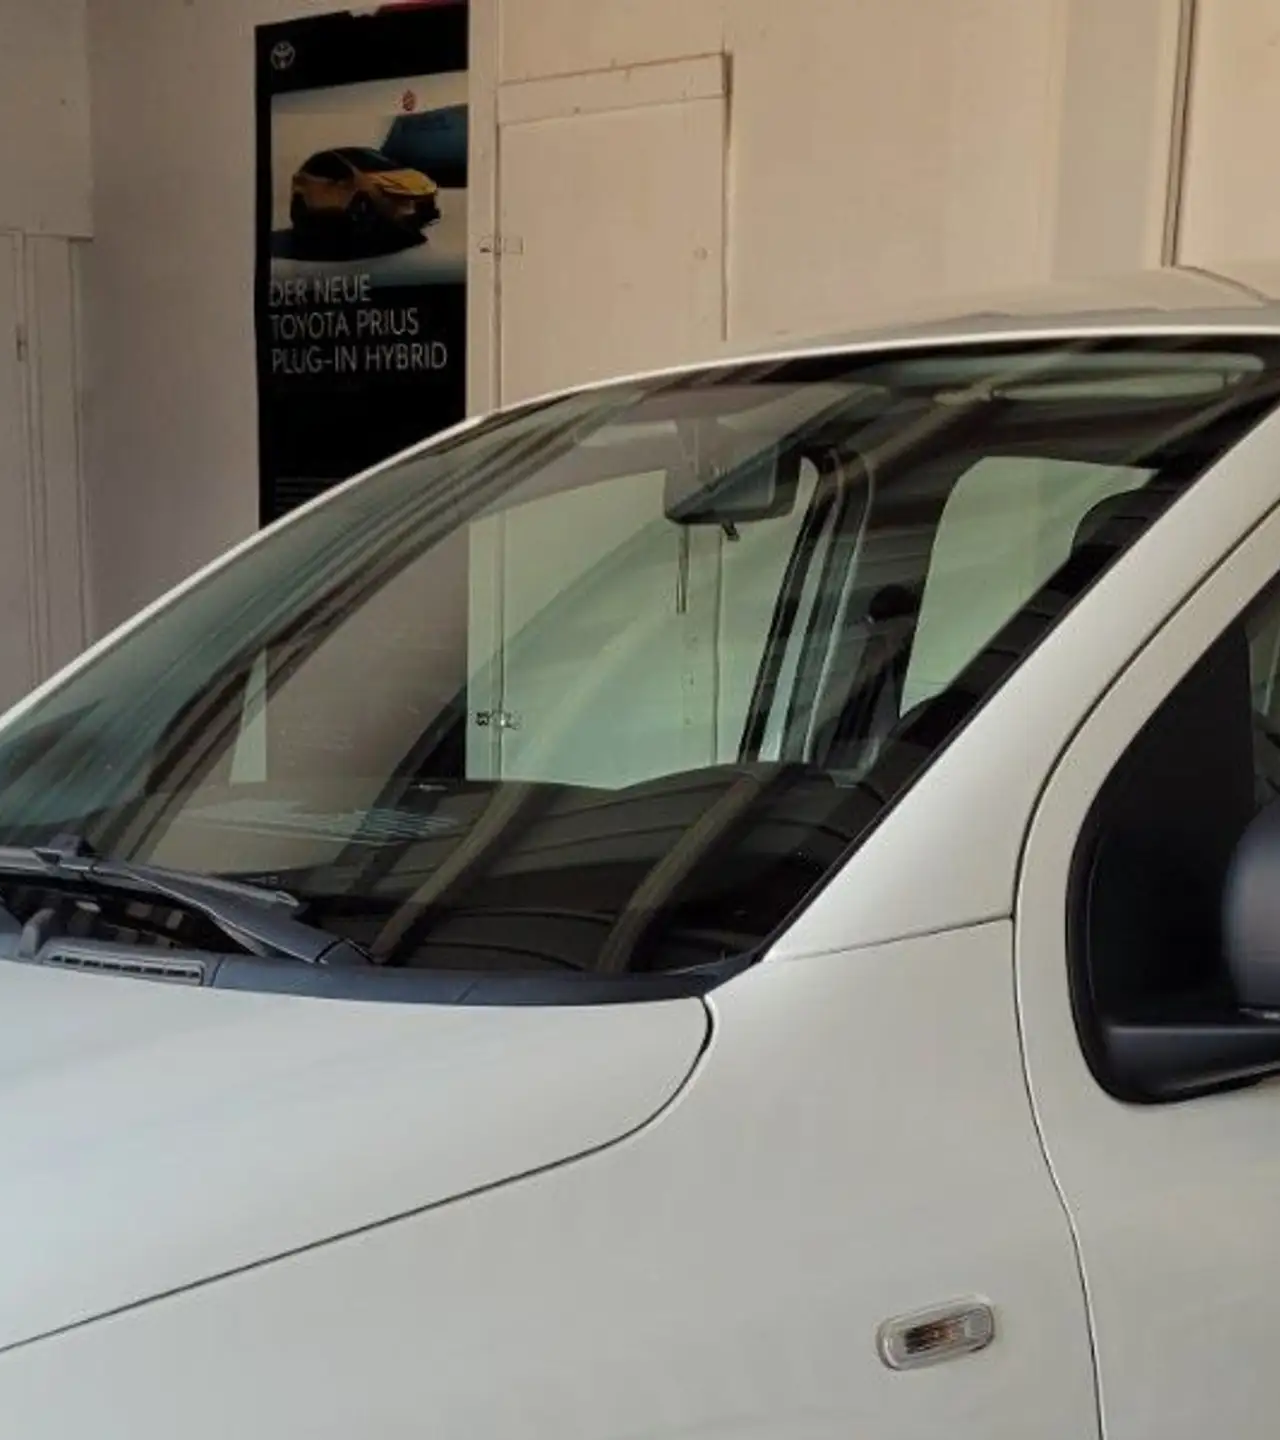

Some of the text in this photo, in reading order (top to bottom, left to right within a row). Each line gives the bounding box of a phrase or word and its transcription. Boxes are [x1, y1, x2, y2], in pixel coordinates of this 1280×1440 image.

[269, 274, 372, 307] DER NEUE
[270, 308, 420, 340] TOYOTA PRIUS
[272, 341, 448, 373] PLUG-IN HYBRID
